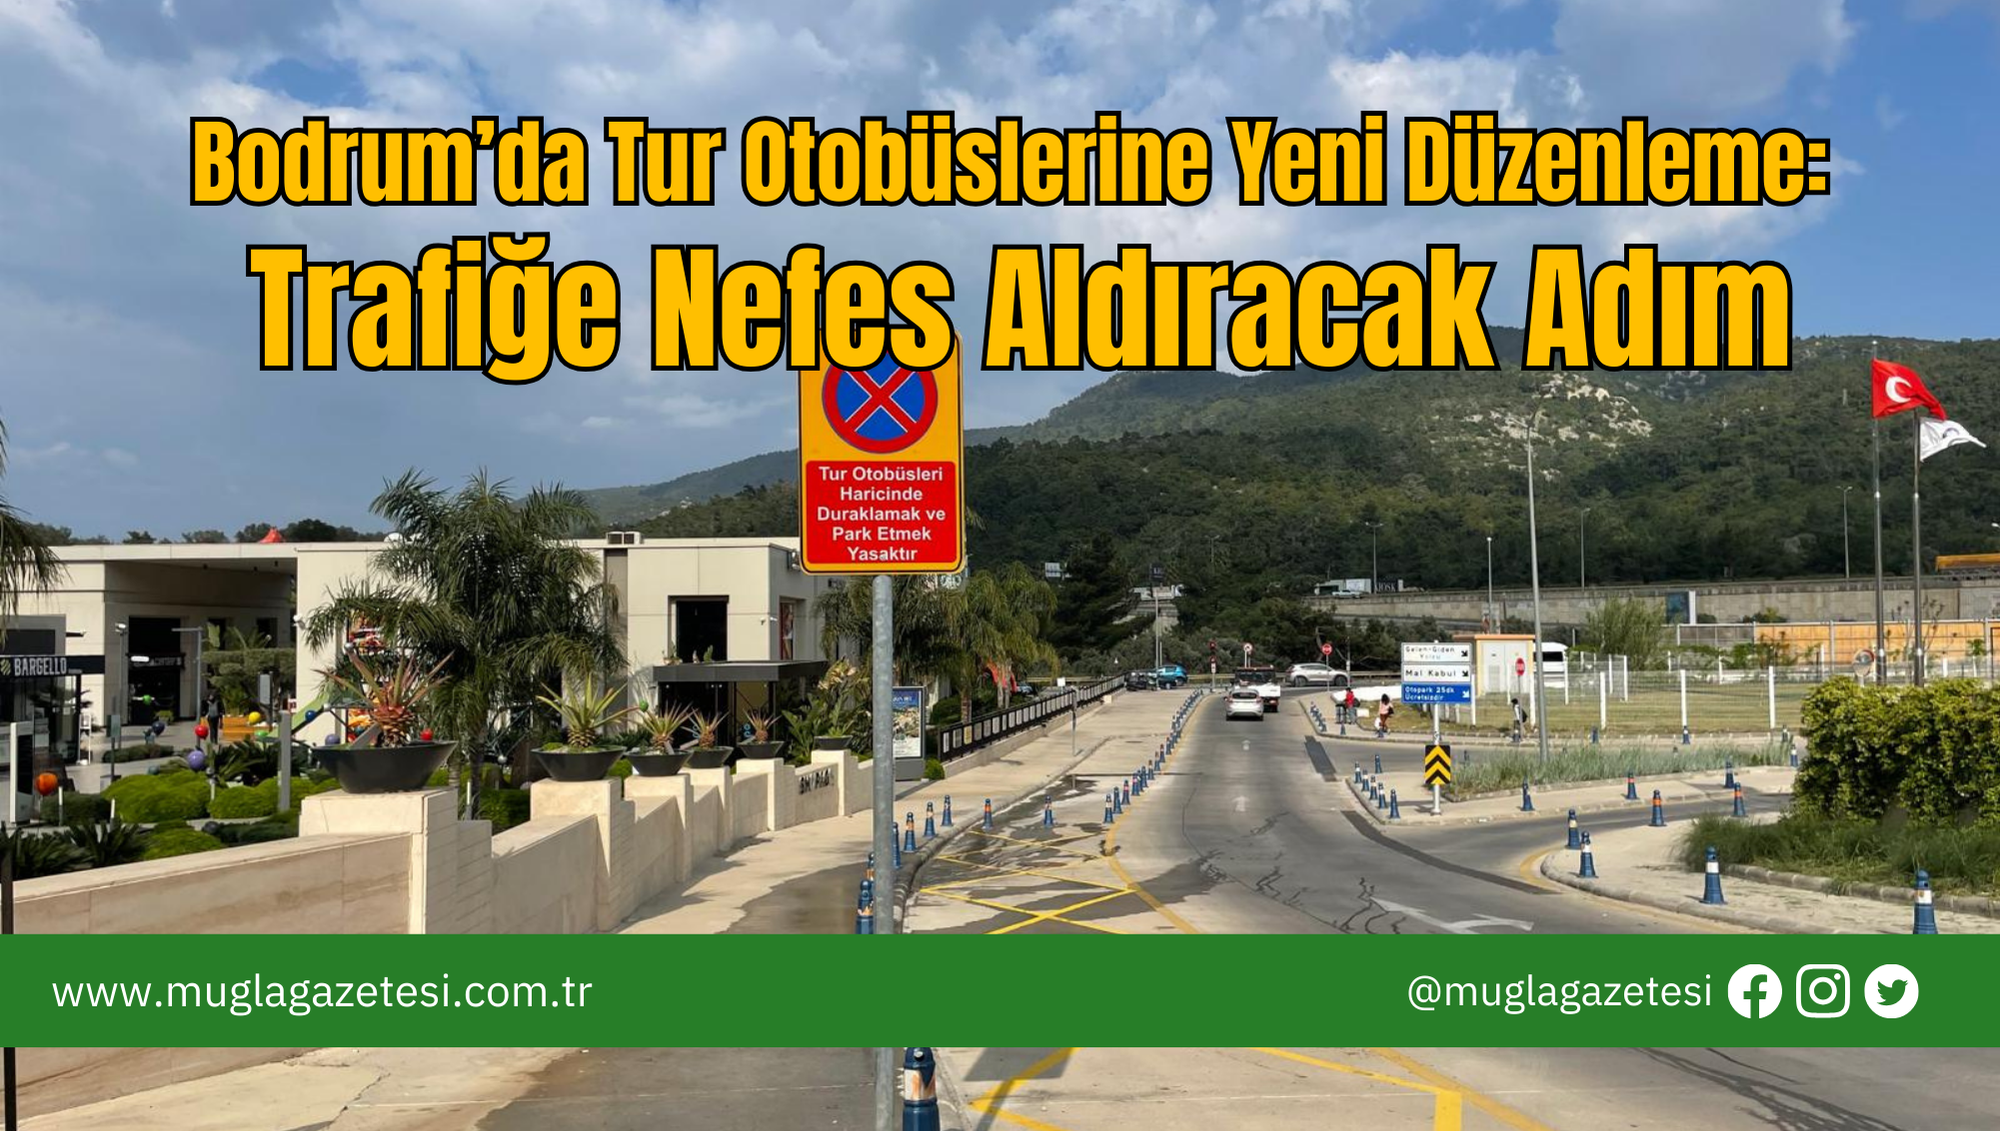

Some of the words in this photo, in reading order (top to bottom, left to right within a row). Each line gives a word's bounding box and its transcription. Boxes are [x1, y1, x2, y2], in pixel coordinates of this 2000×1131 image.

[818, 466, 847, 481] Tur
[852, 466, 943, 481] Otobüsleri
[840, 486, 923, 501] Haricinde
[817, 506, 921, 521] Duraklamak
[926, 509, 946, 521] ve
[832, 526, 872, 541] Park
[877, 526, 931, 541] Etmek
[847, 546, 918, 561] Yasaktır
[14, 657, 67, 676] BARGELLO
[1405, 669, 1423, 677] Mal
[1428, 669, 1457, 677] Kabul
[1404, 686, 1433, 694] Otopark
